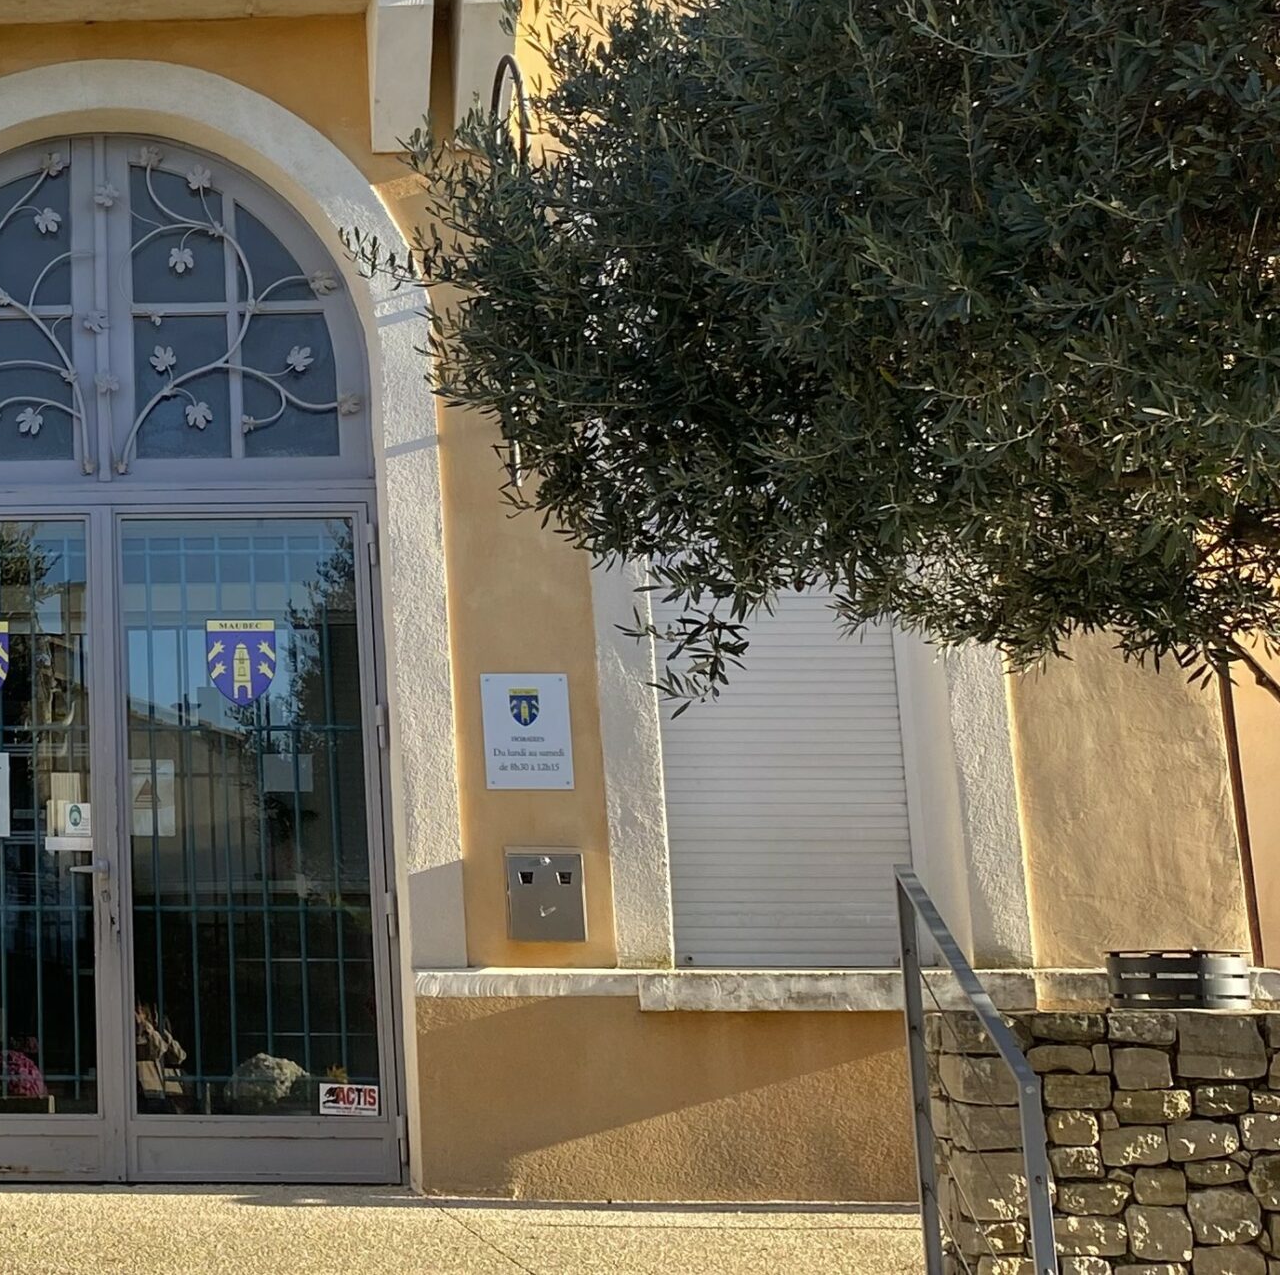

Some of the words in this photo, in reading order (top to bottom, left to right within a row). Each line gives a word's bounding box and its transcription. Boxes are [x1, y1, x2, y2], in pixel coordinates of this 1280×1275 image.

[218, 622, 263, 630] MAUBEC
[493, 748, 506, 757] Du
[507, 748, 527, 757] lundi
[538, 748, 565, 757] samedi
[498, 763, 508, 771] de
[510, 763, 529, 771] 8h30
[537, 763, 560, 772] 12h15
[336, 1086, 377, 1106] ACTIS
